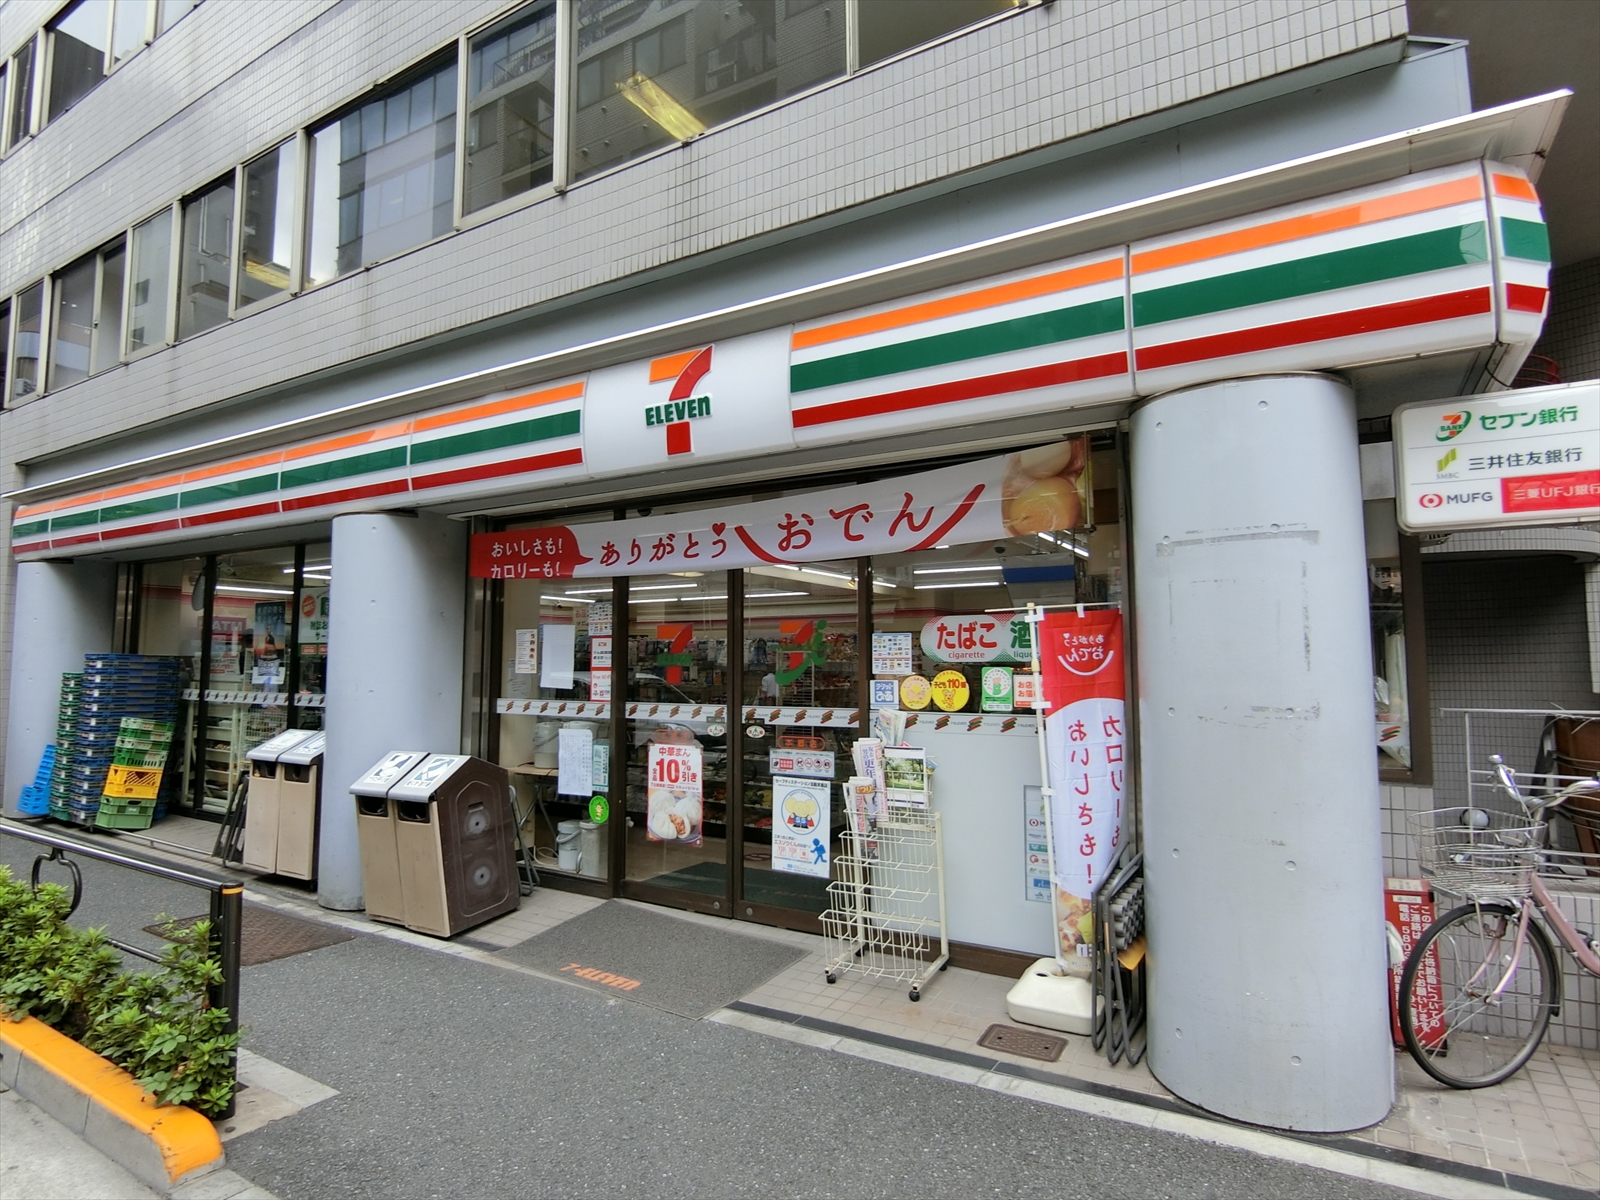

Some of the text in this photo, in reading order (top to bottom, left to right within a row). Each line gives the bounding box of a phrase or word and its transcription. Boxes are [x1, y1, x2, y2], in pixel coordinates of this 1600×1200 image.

[1479, 405, 1578, 431] セブン銀行
[1468, 447, 1583, 471] 三井住友銀行
[1436, 472, 1460, 480] SMBC
[1446, 491, 1493, 505] MUFG
[777, 491, 935, 552] おでん
[491, 538, 563, 558] おいしさも!
[600, 533, 727, 566] ありがとう
[491, 561, 561, 579] カロリーも!
[936, 621, 998, 649] たばこ
[1010, 621, 1039, 649] 酒
[948, 650, 985, 659] cigarette
[1014, 650, 1033, 659] liqu
[659, 746, 691, 758] 中華まん
